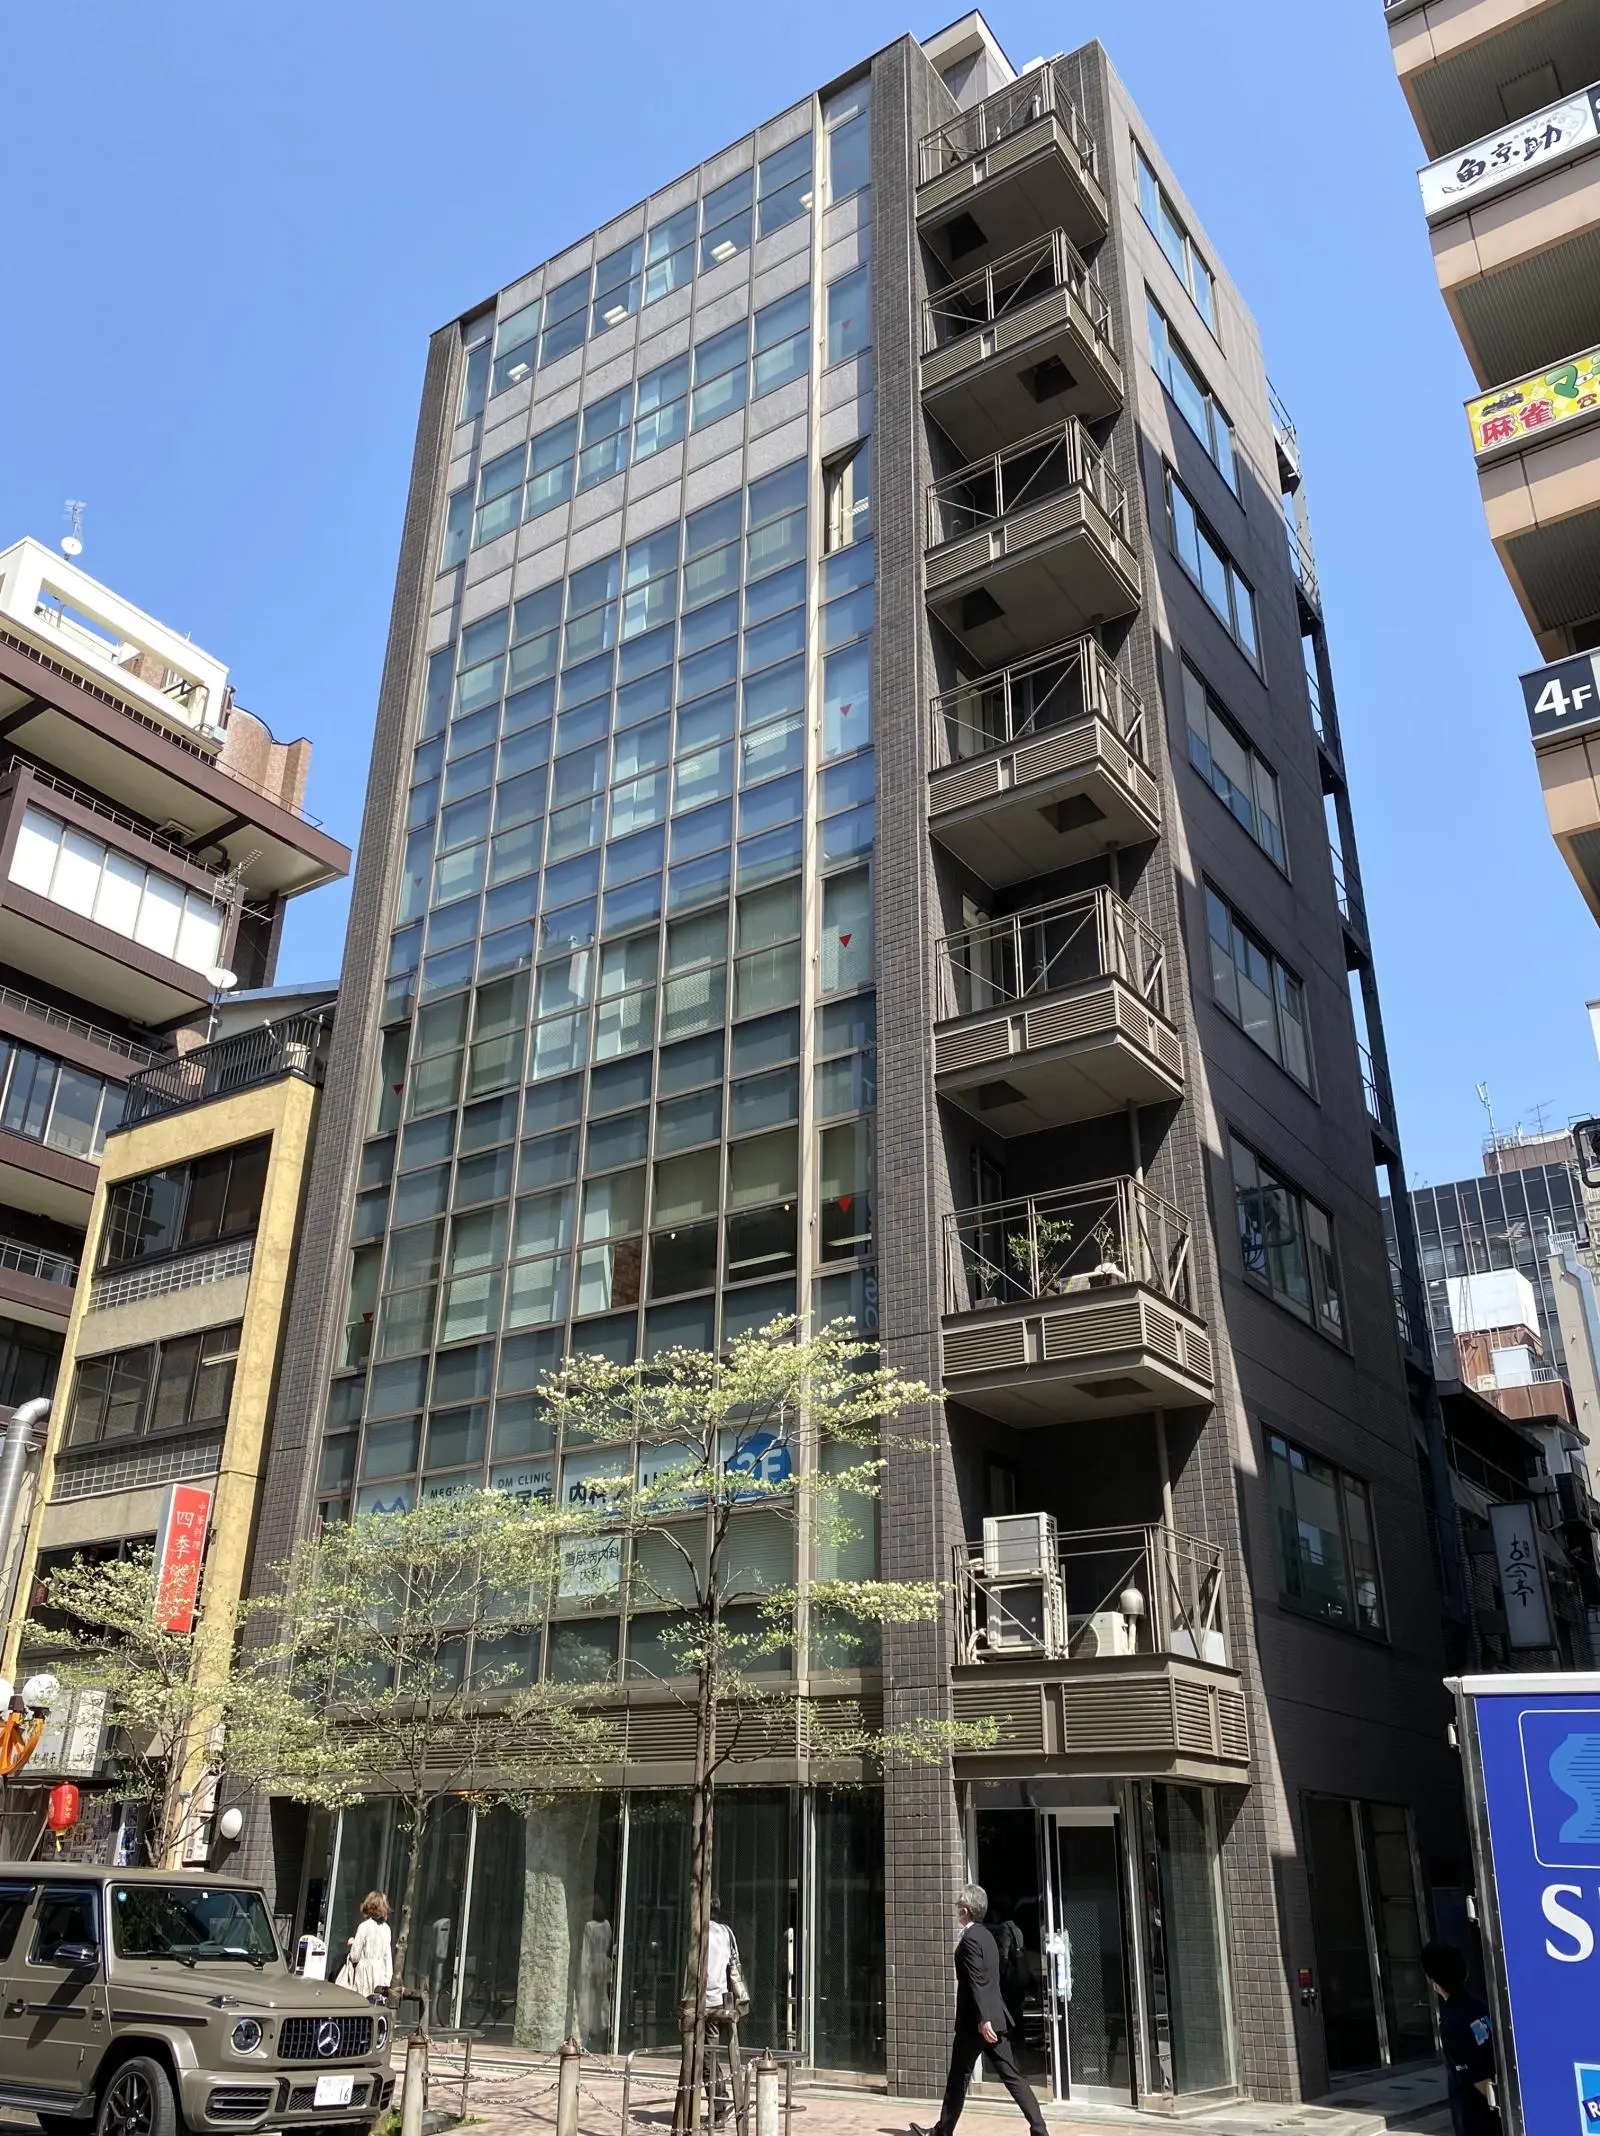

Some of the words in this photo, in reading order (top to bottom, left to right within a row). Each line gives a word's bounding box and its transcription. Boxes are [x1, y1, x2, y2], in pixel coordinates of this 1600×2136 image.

[1480, 399, 1555, 446] 麻雀
[1534, 678, 1592, 716] 4F
[497, 1477, 513, 1489] DM
[518, 1471, 552, 1486] CLINIC
[1541, 1884, 1600, 1963] S
